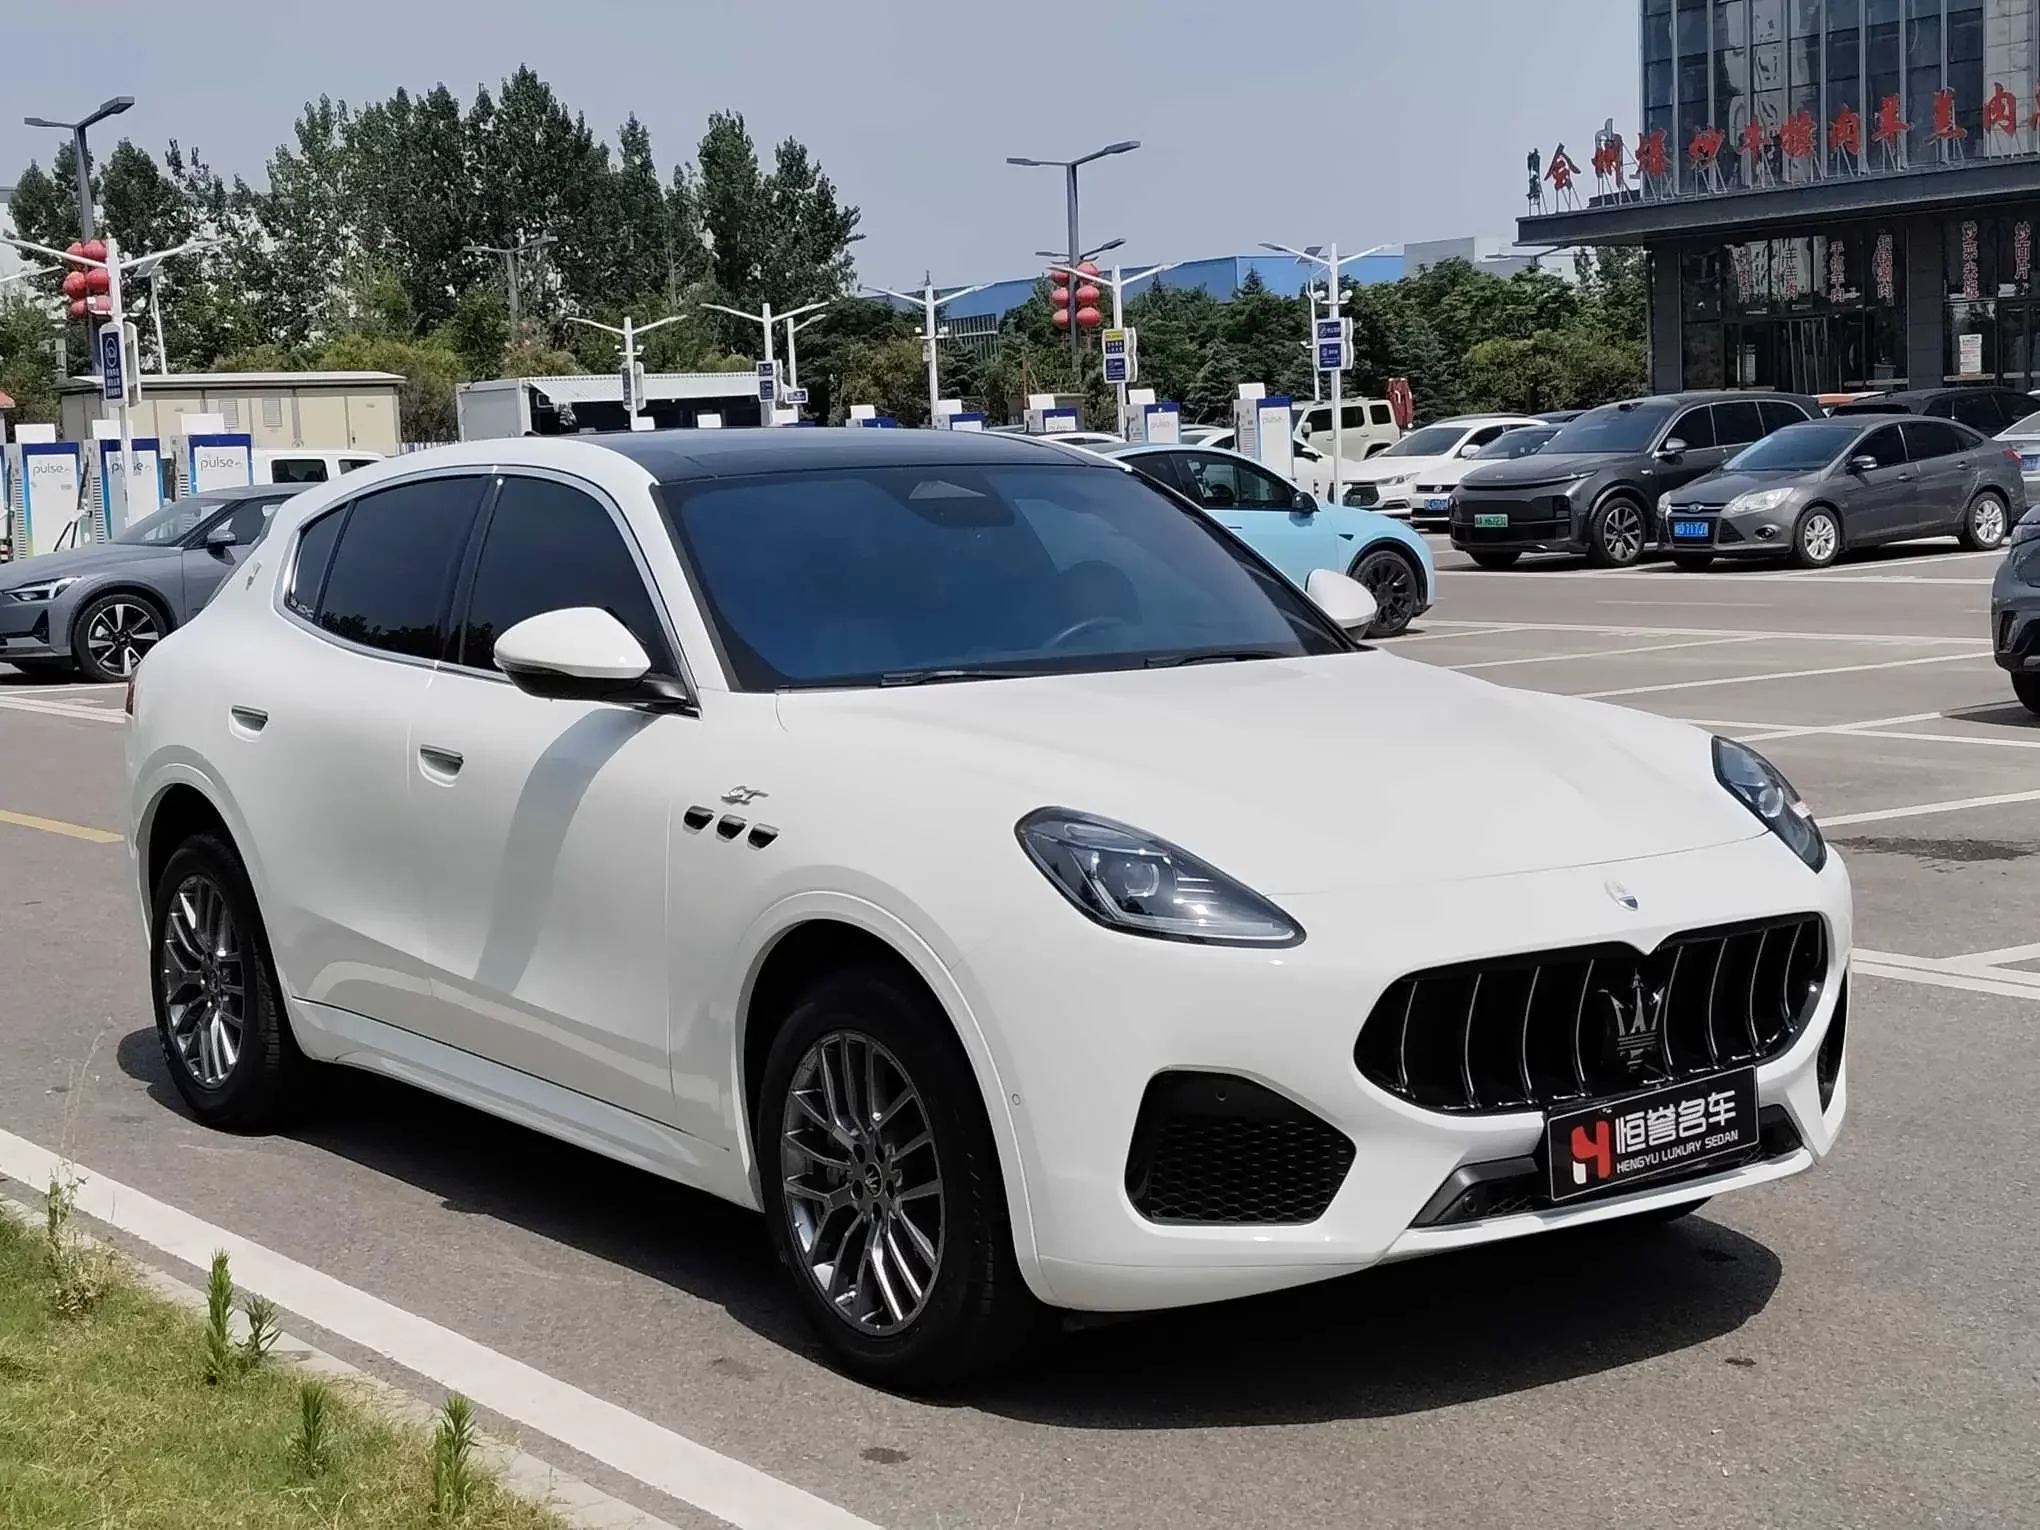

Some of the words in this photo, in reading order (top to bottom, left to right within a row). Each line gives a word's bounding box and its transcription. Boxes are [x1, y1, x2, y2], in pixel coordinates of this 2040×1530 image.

[33, 463, 64, 477] pulse
[200, 456, 234, 471] pulse
[1615, 1090, 1736, 1155] 恒誉名车
[1616, 1153, 1660, 1174] HENGYU
[1661, 1140, 1702, 1162] LUXURY
[1704, 1129, 1739, 1149] SEDAN
